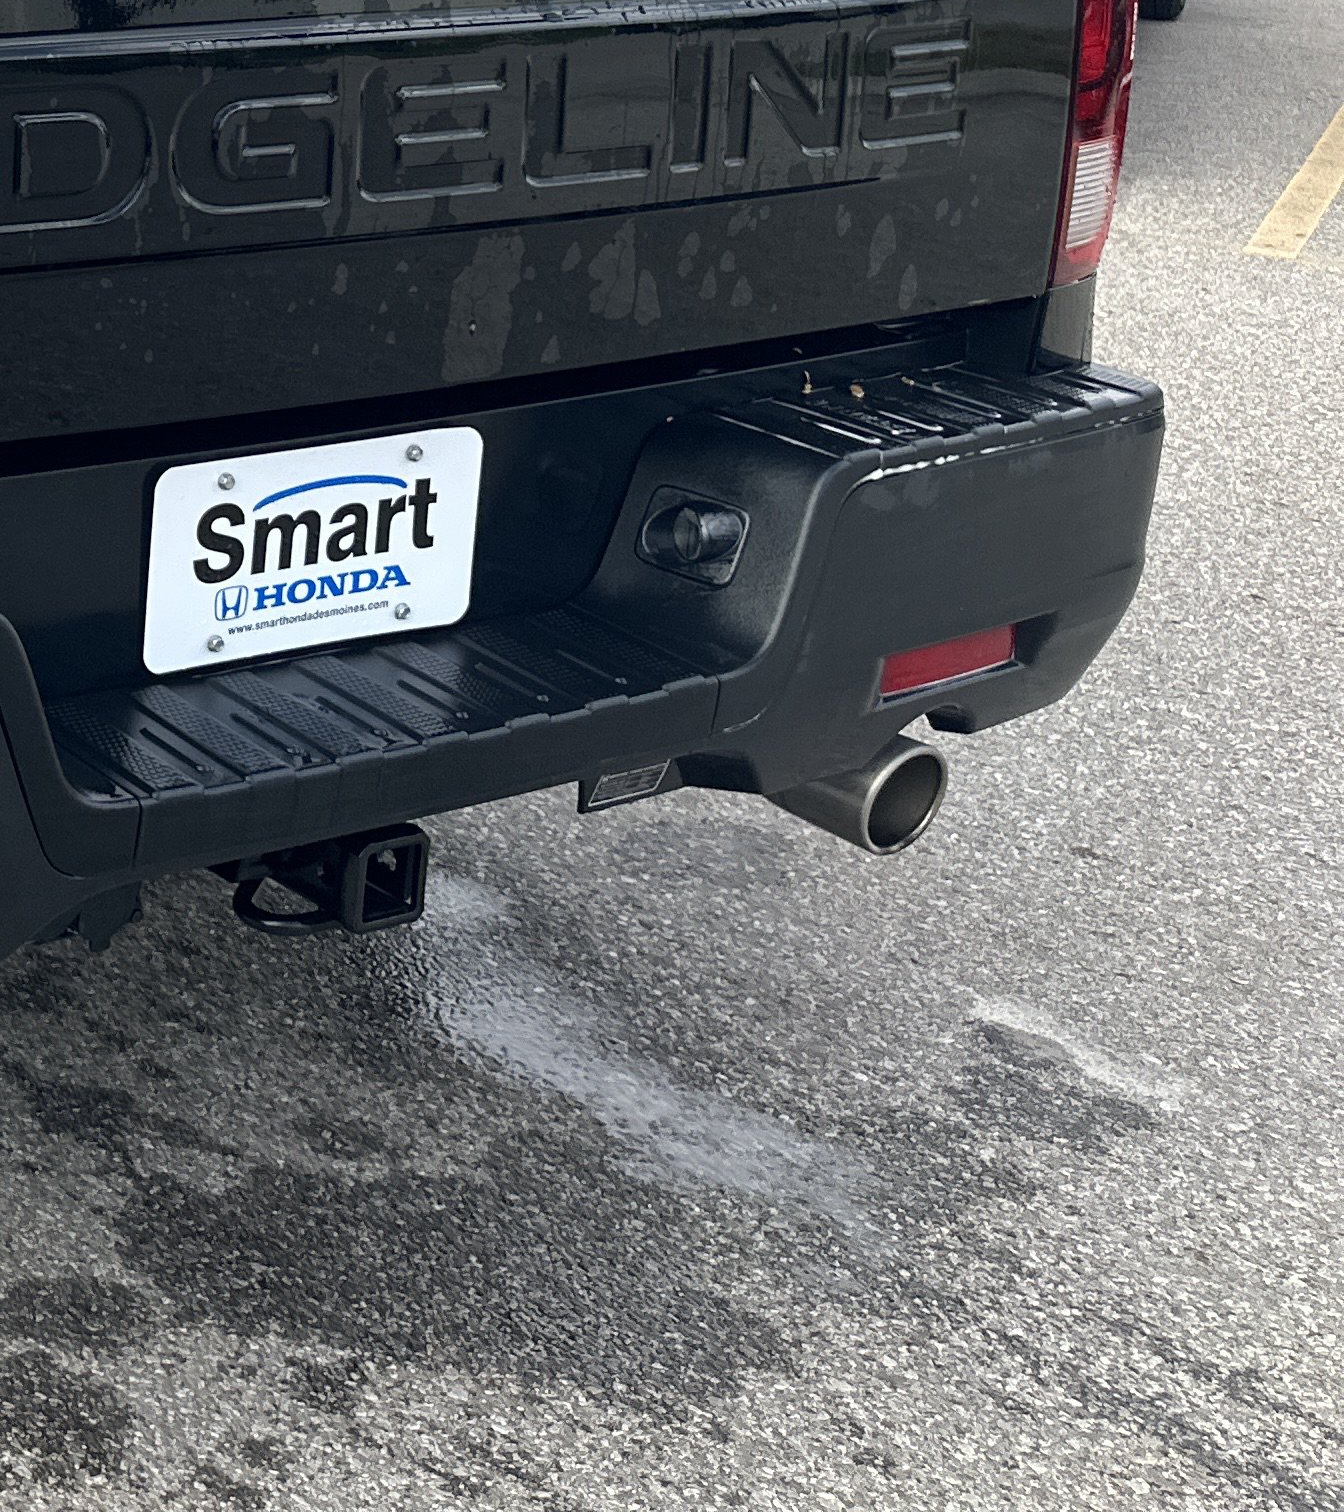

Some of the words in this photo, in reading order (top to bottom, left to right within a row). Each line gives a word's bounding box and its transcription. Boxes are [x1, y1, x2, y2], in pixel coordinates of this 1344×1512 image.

[192, 477, 438, 585] Smart
[252, 564, 411, 612] HONDA
[227, 599, 390, 636] www.smarthondadesmoines.com
